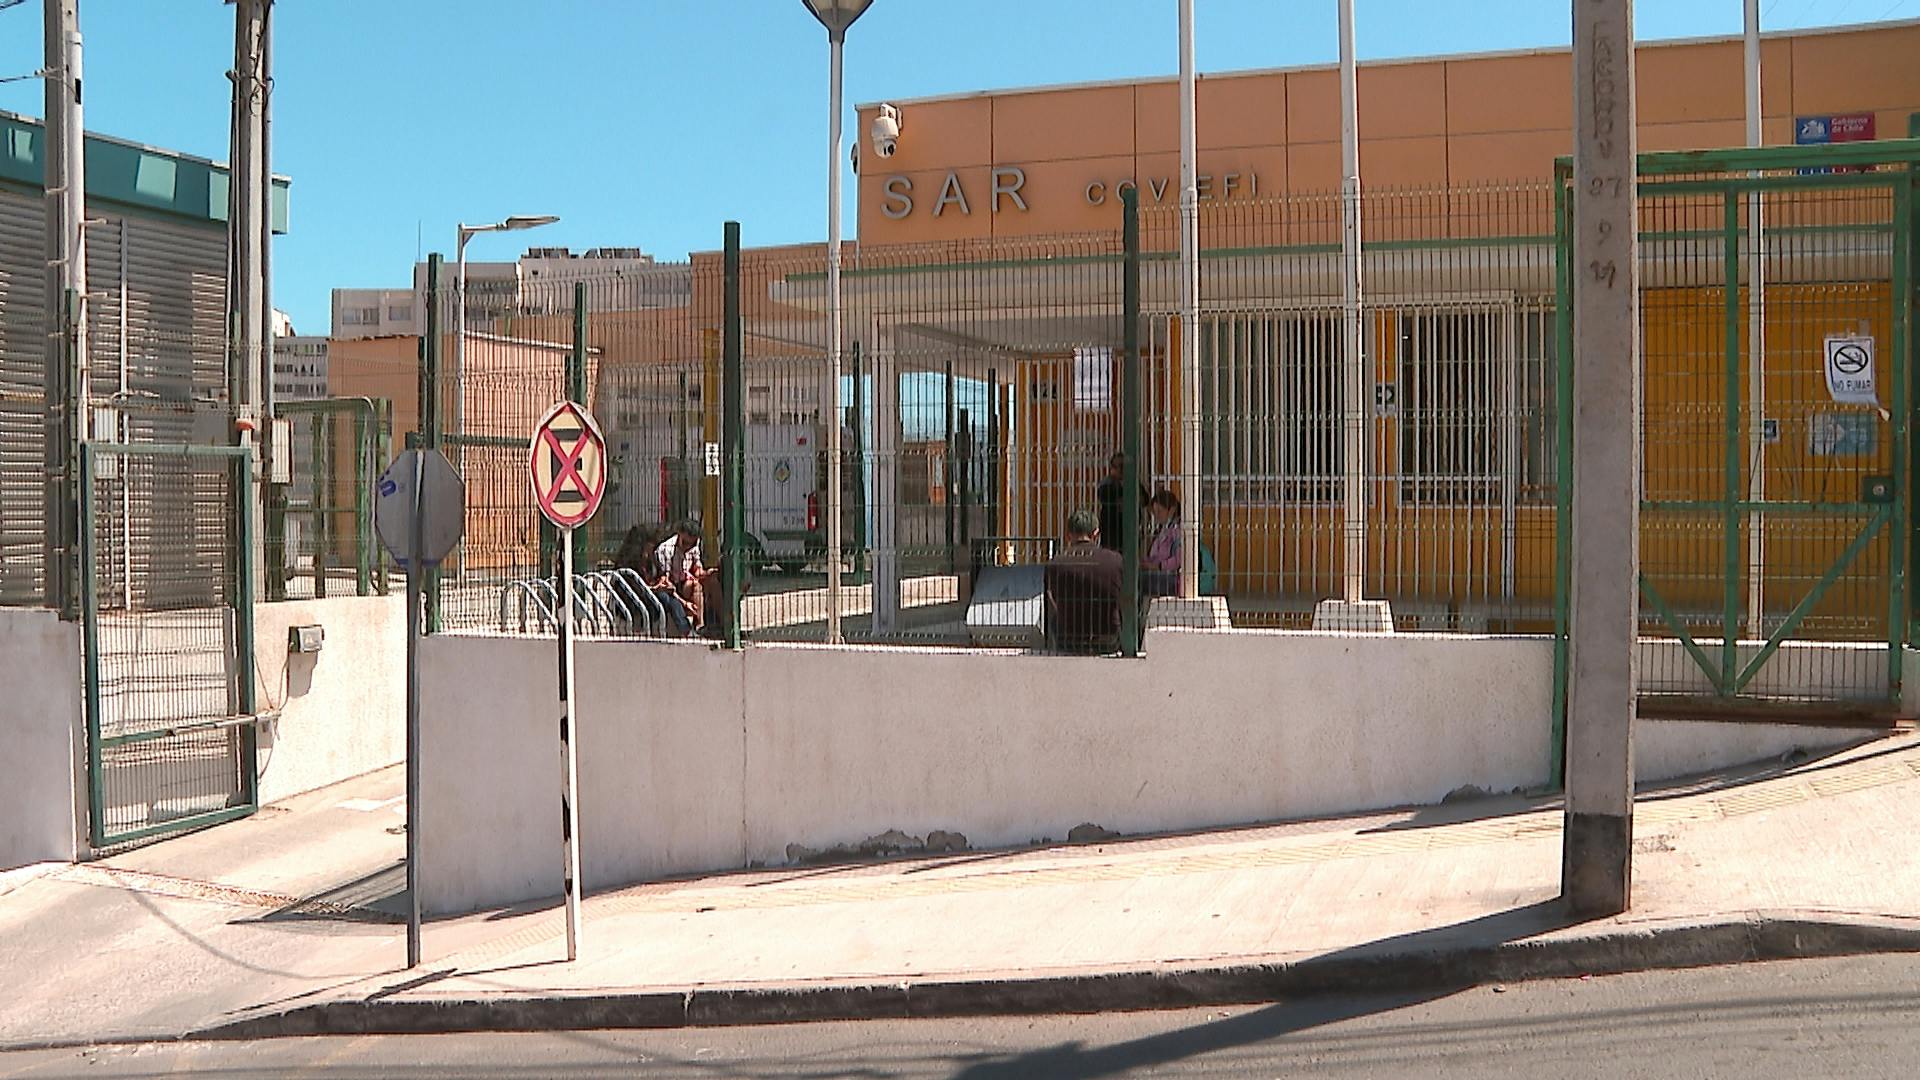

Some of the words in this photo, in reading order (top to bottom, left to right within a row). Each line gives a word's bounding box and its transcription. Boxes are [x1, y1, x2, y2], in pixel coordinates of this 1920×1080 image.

[880, 166, 1029, 220] SAR
[1085, 172, 1258, 206] COVEFI
[1847, 379, 1871, 391] FUMAR
